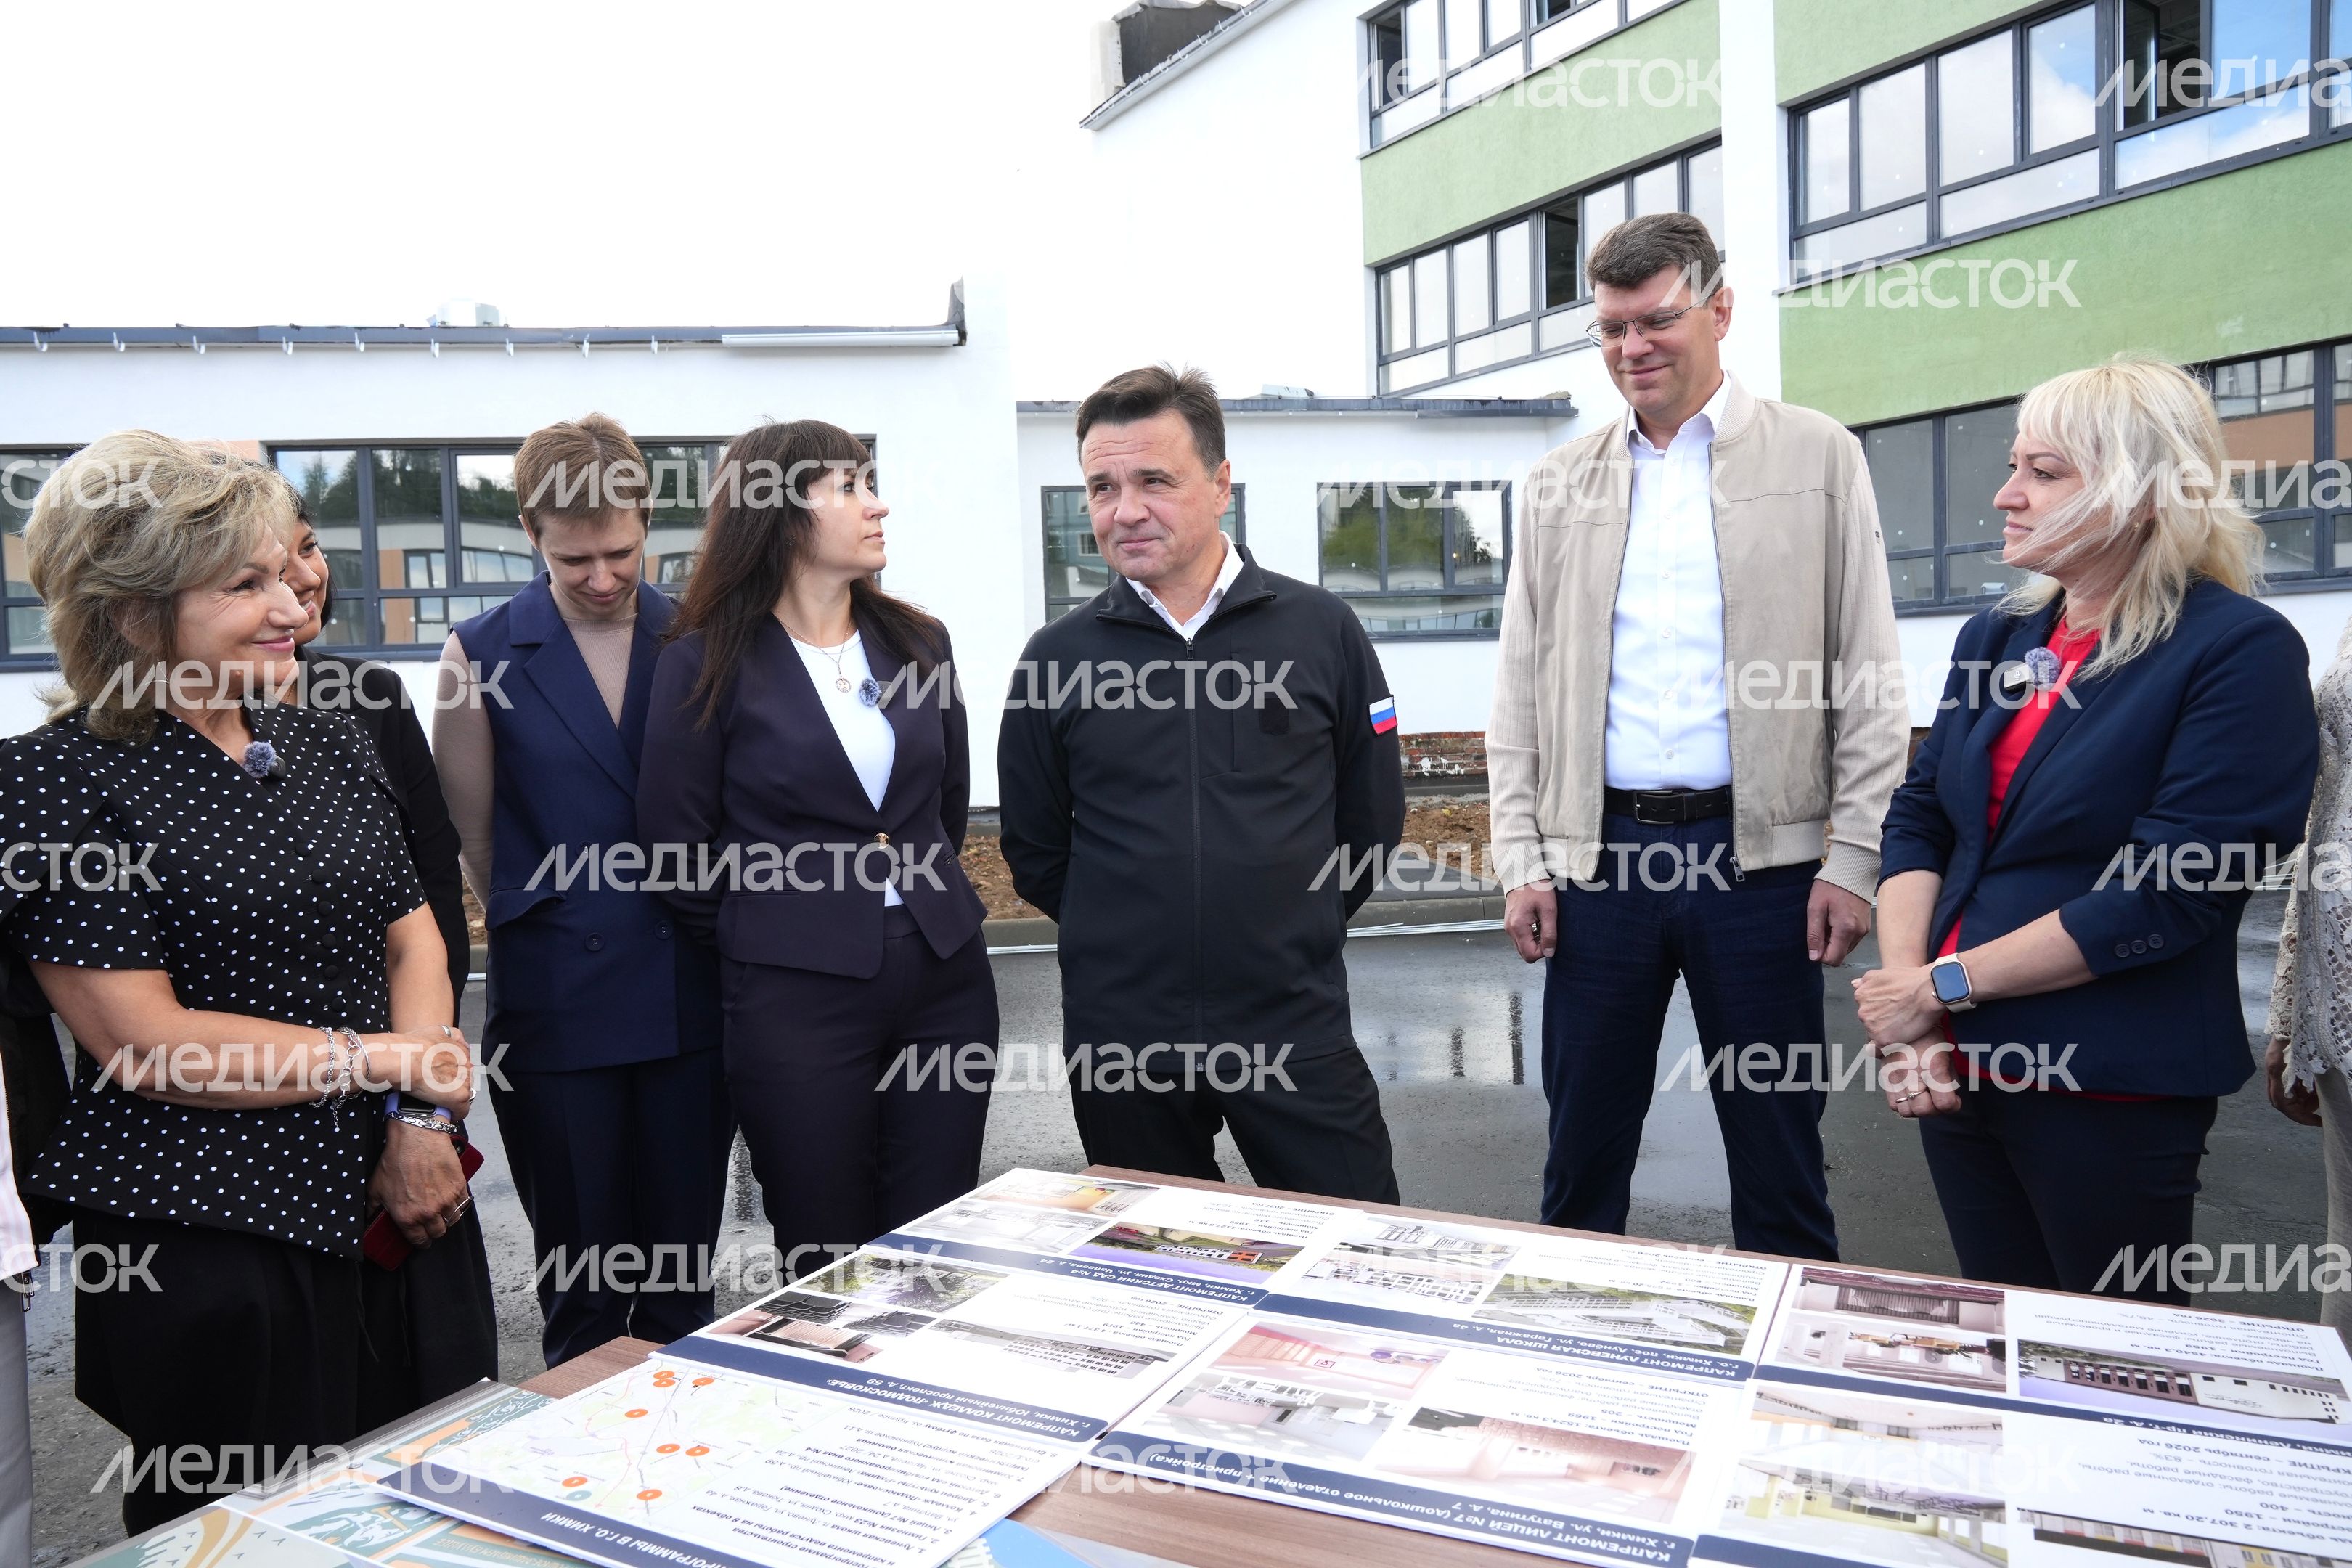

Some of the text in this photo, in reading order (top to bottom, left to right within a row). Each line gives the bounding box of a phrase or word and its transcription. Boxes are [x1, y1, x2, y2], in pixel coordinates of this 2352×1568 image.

[1116, 1275, 1175, 1290] ДЕТСКИЙ
[1132, 1273, 1175, 1283] Сходня,
[1172, 1285, 1249, 1302] КАПРЕМОНТ
[1203, 1283, 1246, 1294] Химки,
[1487, 1328, 1553, 1343] Гаражная,
[1496, 1336, 1736, 1378] КАПРЕМОНТ ЛУНЕВСКАЯ ШКОЛА
[1663, 1353, 1713, 1366] Химки,
[896, 1384, 957, 1400] проспект,
[825, 1378, 1081, 1438] КАПРЕМОНТ КОЛЛЕДЖ «ПОДМОСКОВЬЕ»
[953, 1396, 1031, 1417] Юбилейный
[1031, 1412, 1080, 1426] Химки,
[2165, 1443, 2201, 1453] 2026
[2205, 1448, 2270, 1463] сентябрь
[1149, 1453, 1244, 1478] пристройка)
[1259, 1474, 1342, 1497] отделение
[779, 1485, 832, 1503] отделение)
[829, 1498, 894, 1519] (дошкольное
[1343, 1490, 1453, 1520] (дошкольное
[1452, 1501, 1463, 1510] 7
[1466, 1503, 1485, 1514] д.
[2259, 1503, 2289, 1512] 400
[688, 1505, 734, 1522] объектах
[889, 1515, 911, 1524] №7
[1453, 1513, 1487, 1527] №7
[1485, 1507, 1565, 1531] Ватутина,
[540, 1511, 594, 1533] ХИМКИ
[852, 1518, 881, 1529] №23
[907, 1519, 943, 1533] Лицей
[1487, 1518, 1553, 1541] ЛИЦЕЙ
[1568, 1522, 1592, 1535] ул.
[597, 1528, 620, 1543] Г.О.
[730, 1527, 800, 1550] строительства
[752, 1523, 791, 1538] работы
[829, 1524, 863, 1537] школа
[878, 1524, 928, 1542] Гимназия
[1593, 1527, 1659, 1548] Химки,
[618, 1535, 632, 1546] В
[788, 1532, 829, 1548] ведутся
[860, 1532, 917, 1551] Луневская
[1554, 1531, 1672, 1563] КАПРЕМОНТ
[825, 1543, 889, 1565] капремонта
